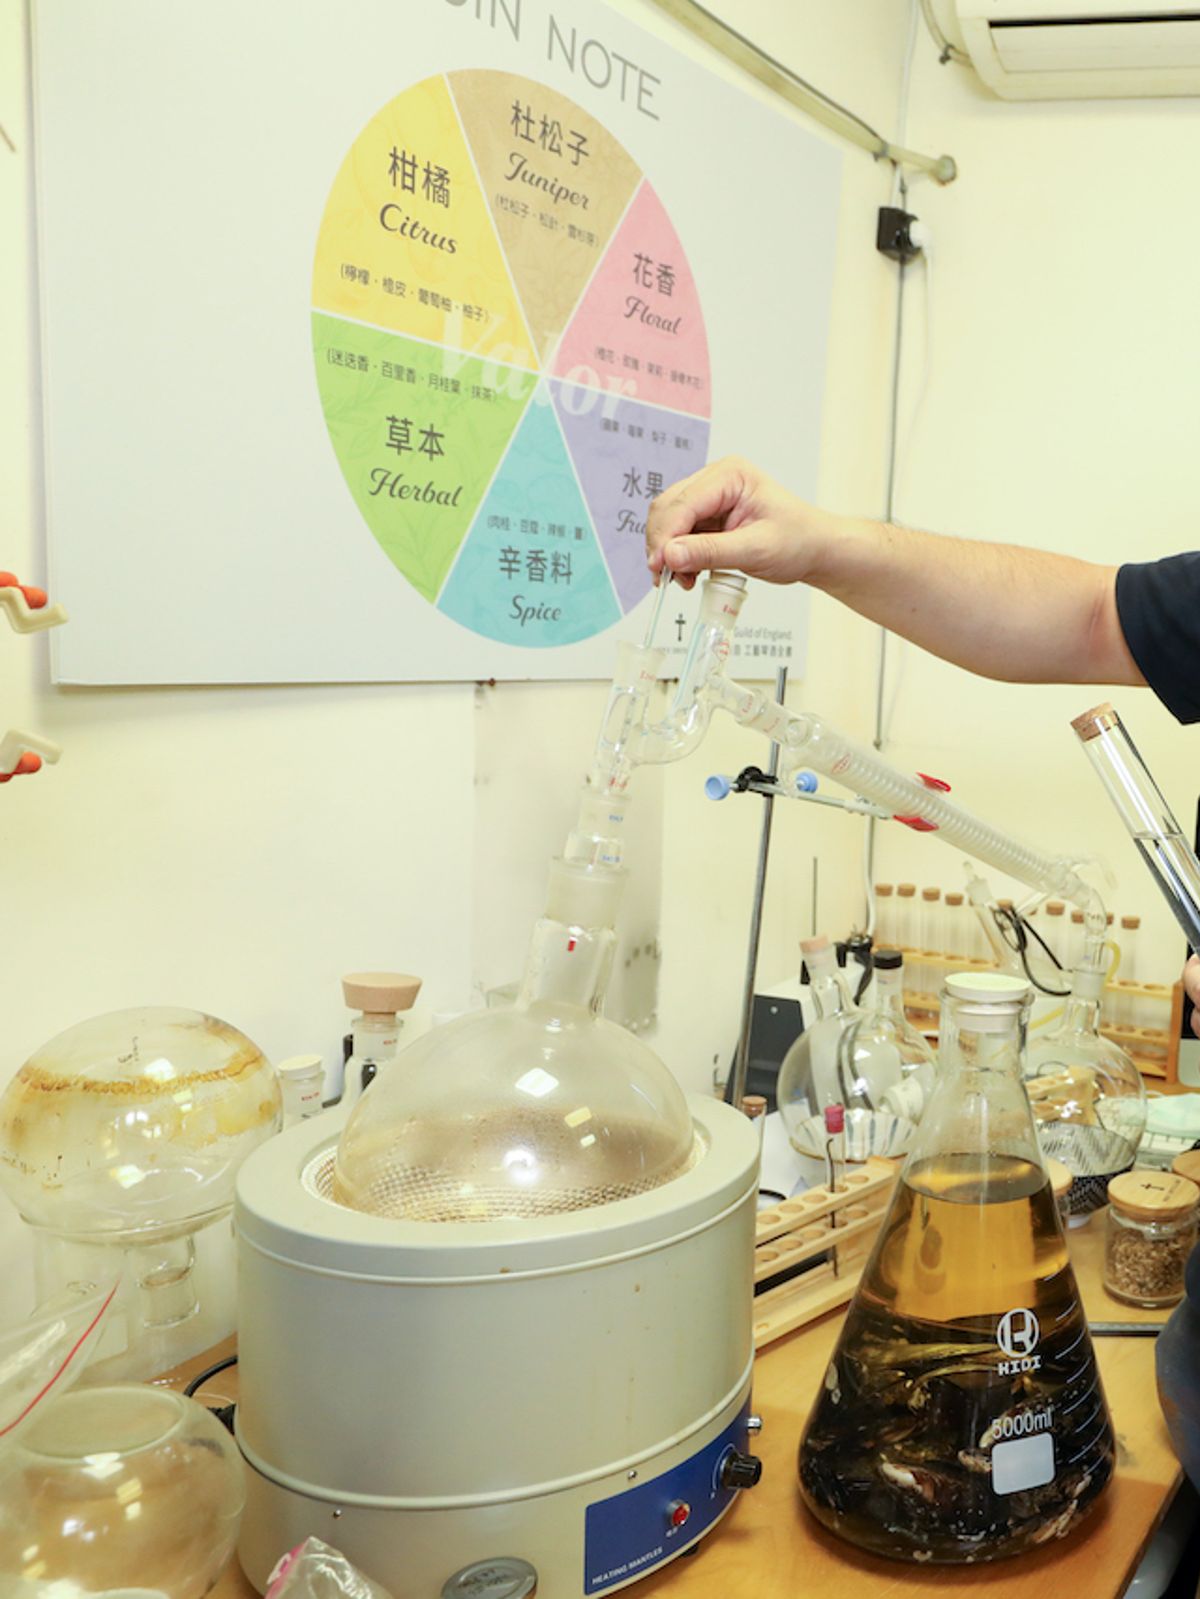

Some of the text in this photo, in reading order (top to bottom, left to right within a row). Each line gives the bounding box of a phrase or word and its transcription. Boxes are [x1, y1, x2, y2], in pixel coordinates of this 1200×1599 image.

[548, 13, 661, 121] NOTE
[511, 99, 590, 167] 杜松子
[388, 146, 451, 208] 柑橘
[504, 152, 591, 211] Juniper
[379, 203, 458, 255] Citrus
[632, 252, 676, 297] 花香
[623, 295, 682, 336] Floral
[385, 414, 446, 462] 草本
[368, 467, 464, 508] Herbal
[622, 466, 665, 500] 水果
[616, 508, 647, 534] Fru
[498, 545, 574, 586] 辛香料
[508, 594, 562, 628] Spice
[591, 1546, 663, 1585] HEATING MANTLES
